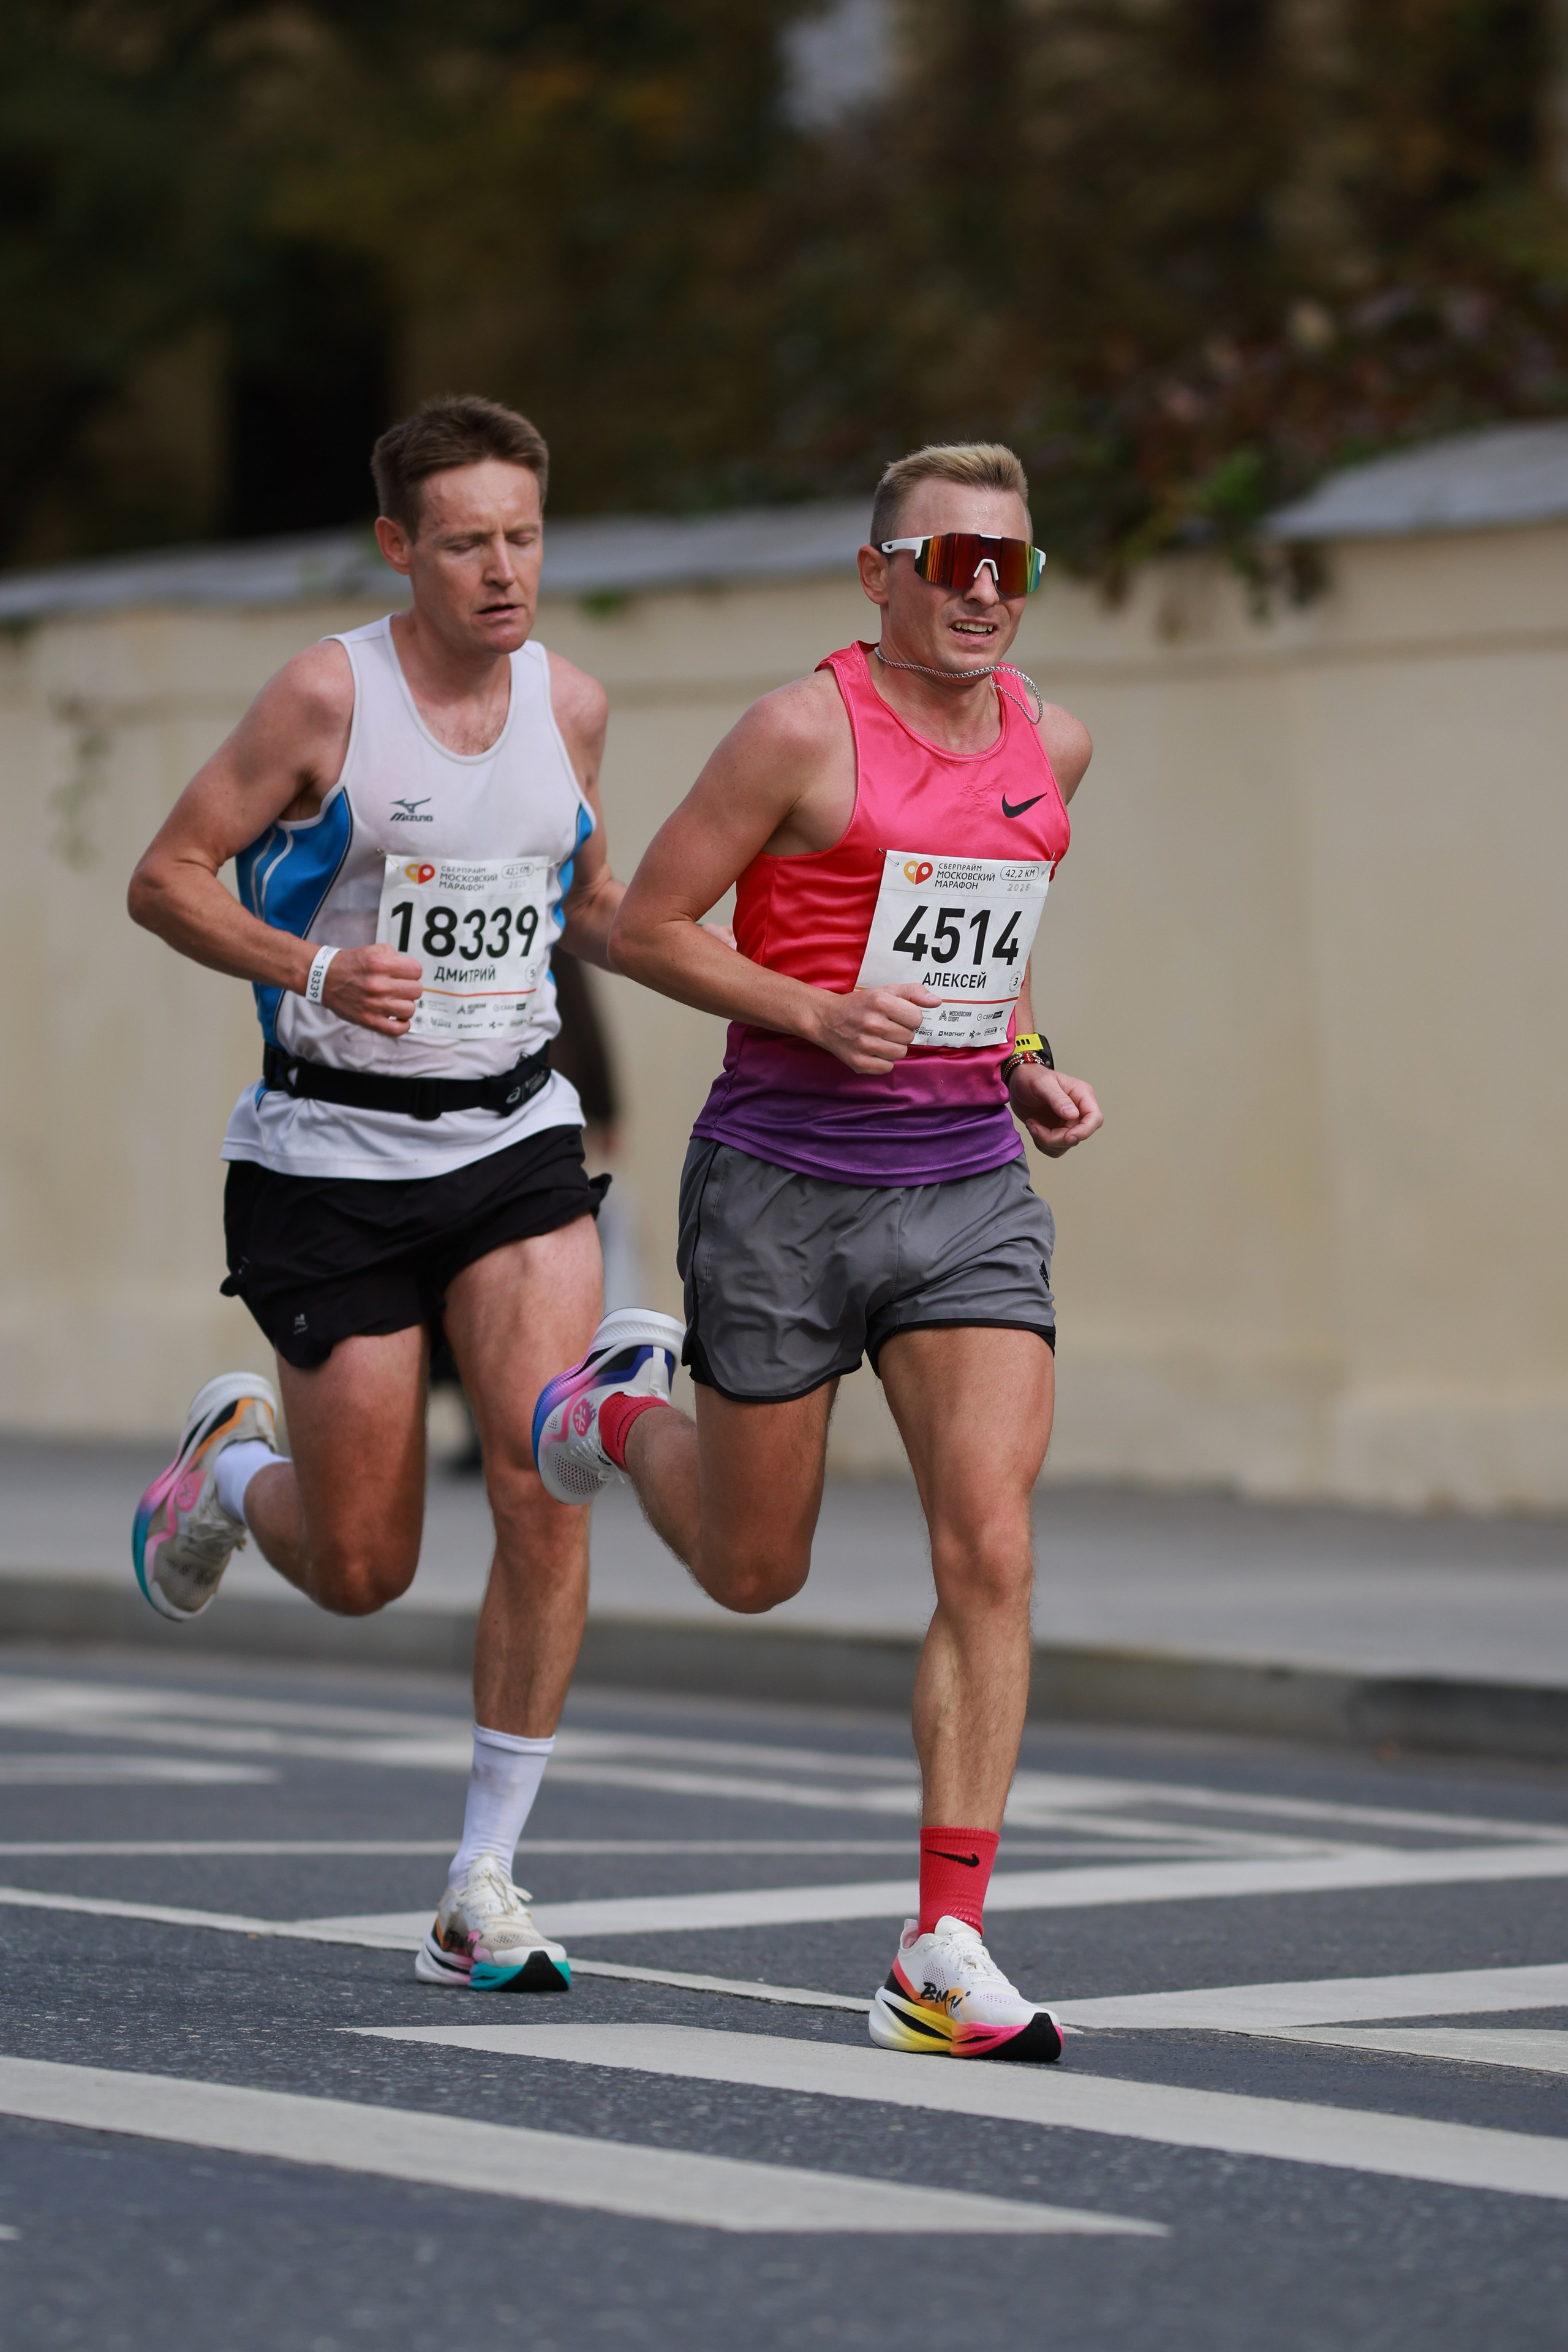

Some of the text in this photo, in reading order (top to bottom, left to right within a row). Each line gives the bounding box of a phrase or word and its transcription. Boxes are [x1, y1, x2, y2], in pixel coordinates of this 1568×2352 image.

[441, 865, 486, 873] СБЕРПРАЙМ
[938, 862, 982, 872] СБЕРПРАЙМ
[440, 872, 498, 883] МОСКОВСКИЙ
[937, 870, 995, 881] МОСКОВСКИЙ
[1005, 869, 1023, 879] 42,2
[439, 881, 484, 891] МАРАФОН
[935, 880, 978, 890] МАРАФОН
[391, 901, 538, 960] 18339
[892, 905, 1022, 966] 4514
[434, 965, 496, 983] ДМИТРИЙ
[530, 969, 535, 978] 5
[309, 965, 324, 998] 18339
[922, 971, 987, 989] АЛЕКСЕЙ
[1013, 977, 1019, 986] 3
